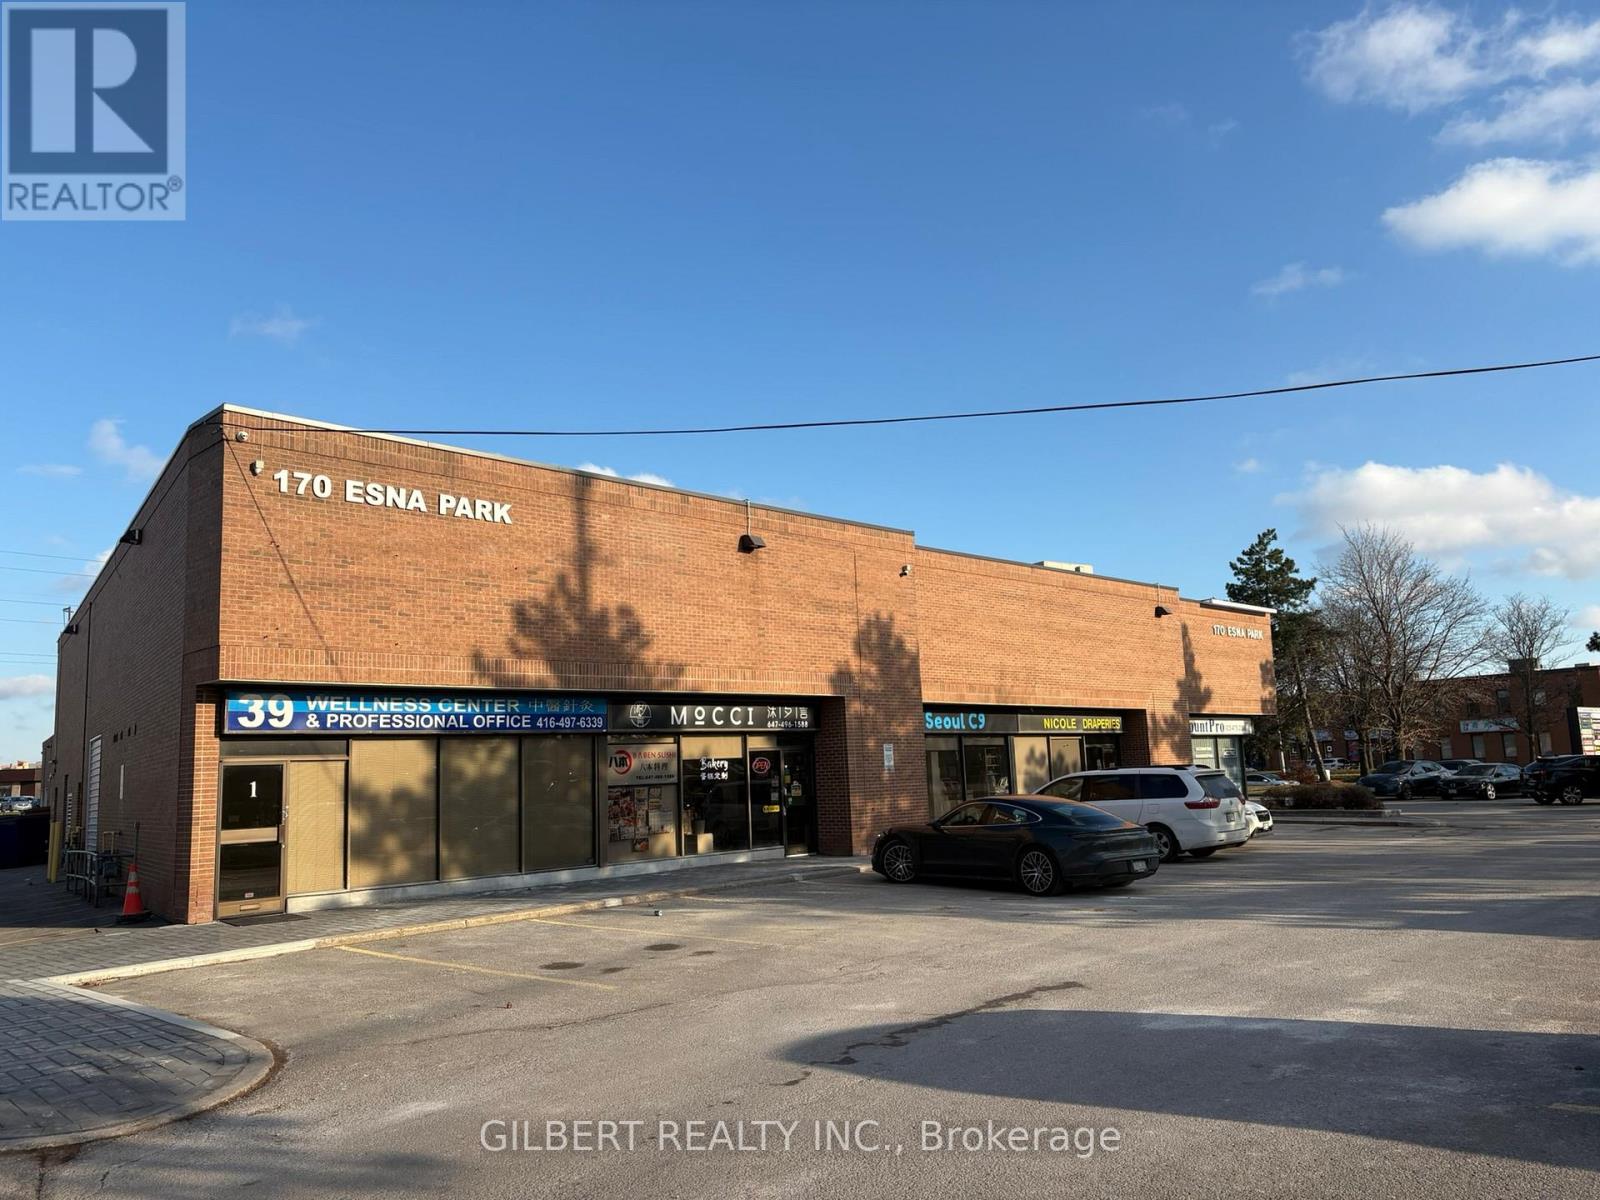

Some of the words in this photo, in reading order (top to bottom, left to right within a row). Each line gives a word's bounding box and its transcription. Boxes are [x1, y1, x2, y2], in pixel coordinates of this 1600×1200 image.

[273, 469, 332, 498] 170
[345, 479, 428, 512] ESNA
[439, 493, 513, 524] PARK
[1213, 624, 1226, 636] 170
[1227, 626, 1246, 639] ESNA
[1246, 628, 1264, 640] PARK
[237, 694, 294, 728] 39
[306, 695, 431, 712] WELLNESS
[438, 698, 520, 713] CENTER
[306, 714, 320, 728] &
[326, 714, 468, 728] PROFESSIONAL
[473, 715, 531, 728] OFFICE
[536, 717, 603, 728] 416-497-6339
[925, 712, 966, 729] Seoul
[968, 713, 986, 729] C9
[1043, 718, 1077, 729] NICOLE
[1082, 718, 1121, 729] DRAPERIES
[700, 757, 729, 771] Bakery
[249, 780, 257, 798] 1
